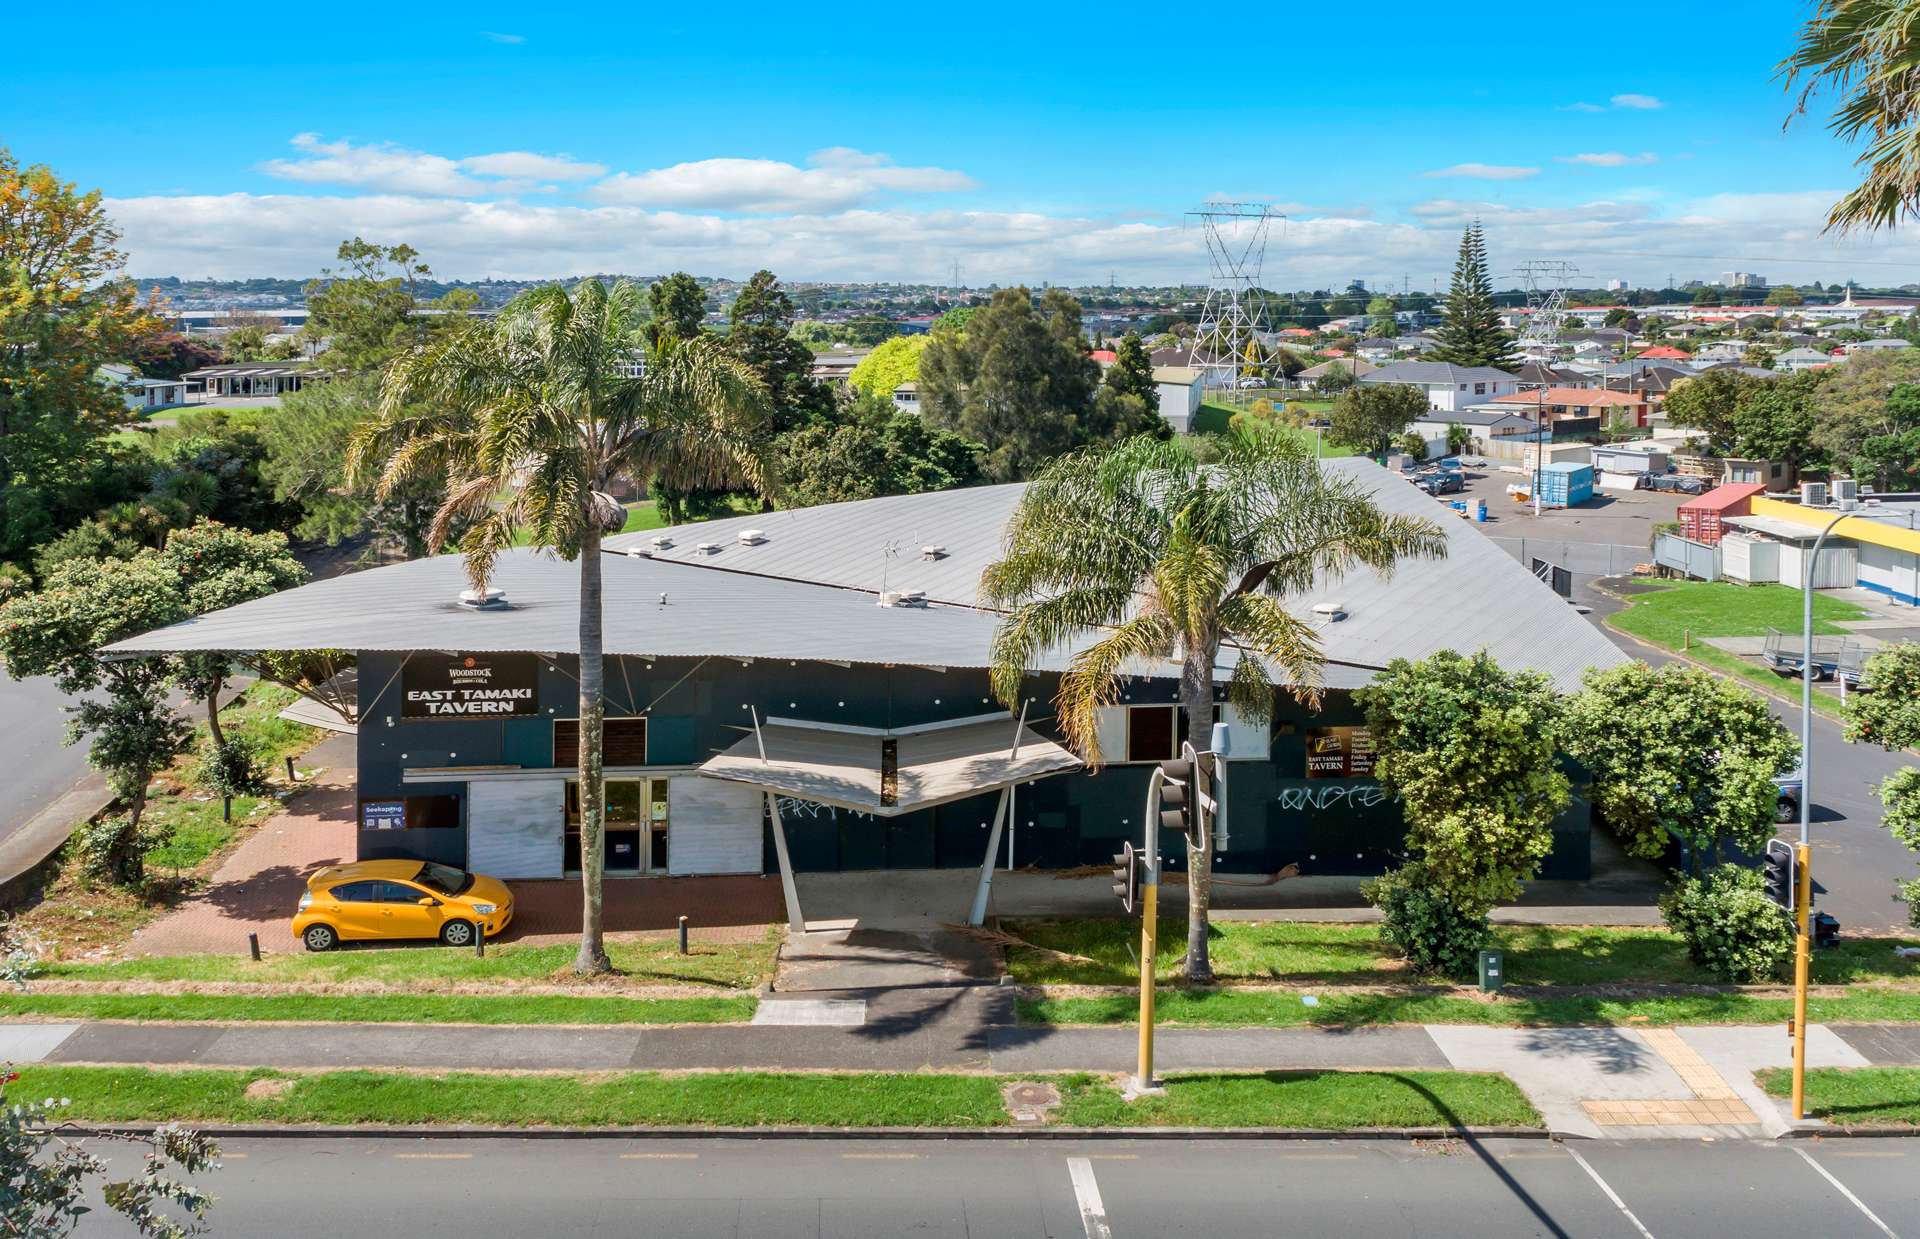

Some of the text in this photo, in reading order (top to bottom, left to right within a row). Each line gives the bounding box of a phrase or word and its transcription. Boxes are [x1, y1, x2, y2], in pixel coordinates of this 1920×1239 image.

[449, 668, 492, 678] WOODSTOCK
[407, 688, 532, 701] EAST TAMAKI
[425, 701, 514, 714] TAVERN
[1309, 762, 1343, 770] TAVERN
